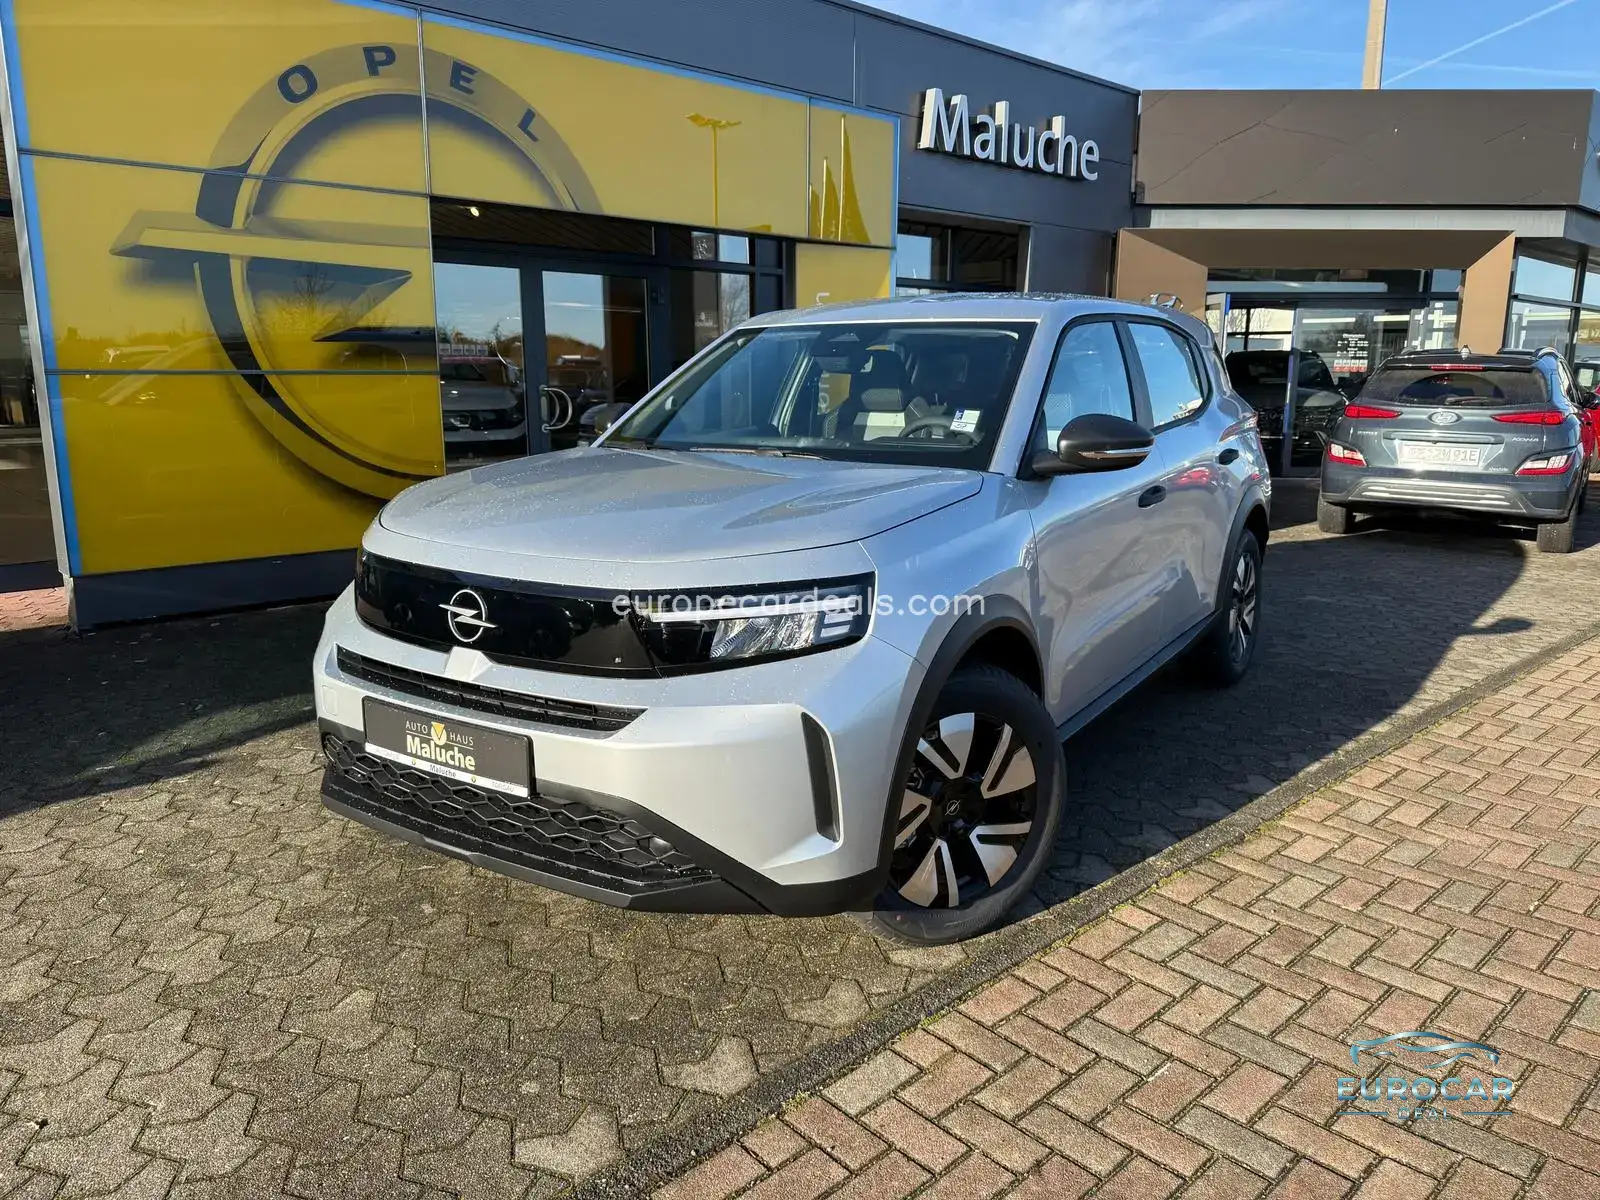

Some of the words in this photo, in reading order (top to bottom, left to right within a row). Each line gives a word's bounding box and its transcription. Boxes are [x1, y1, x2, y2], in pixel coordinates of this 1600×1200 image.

[276, 44, 540, 143] OPEL
[917, 87, 1101, 181] Maluche
[405, 720, 429, 734] AUTO
[449, 731, 475, 746] HAUS
[406, 734, 476, 771] Maluche
[429, 763, 457, 778] Maluche
